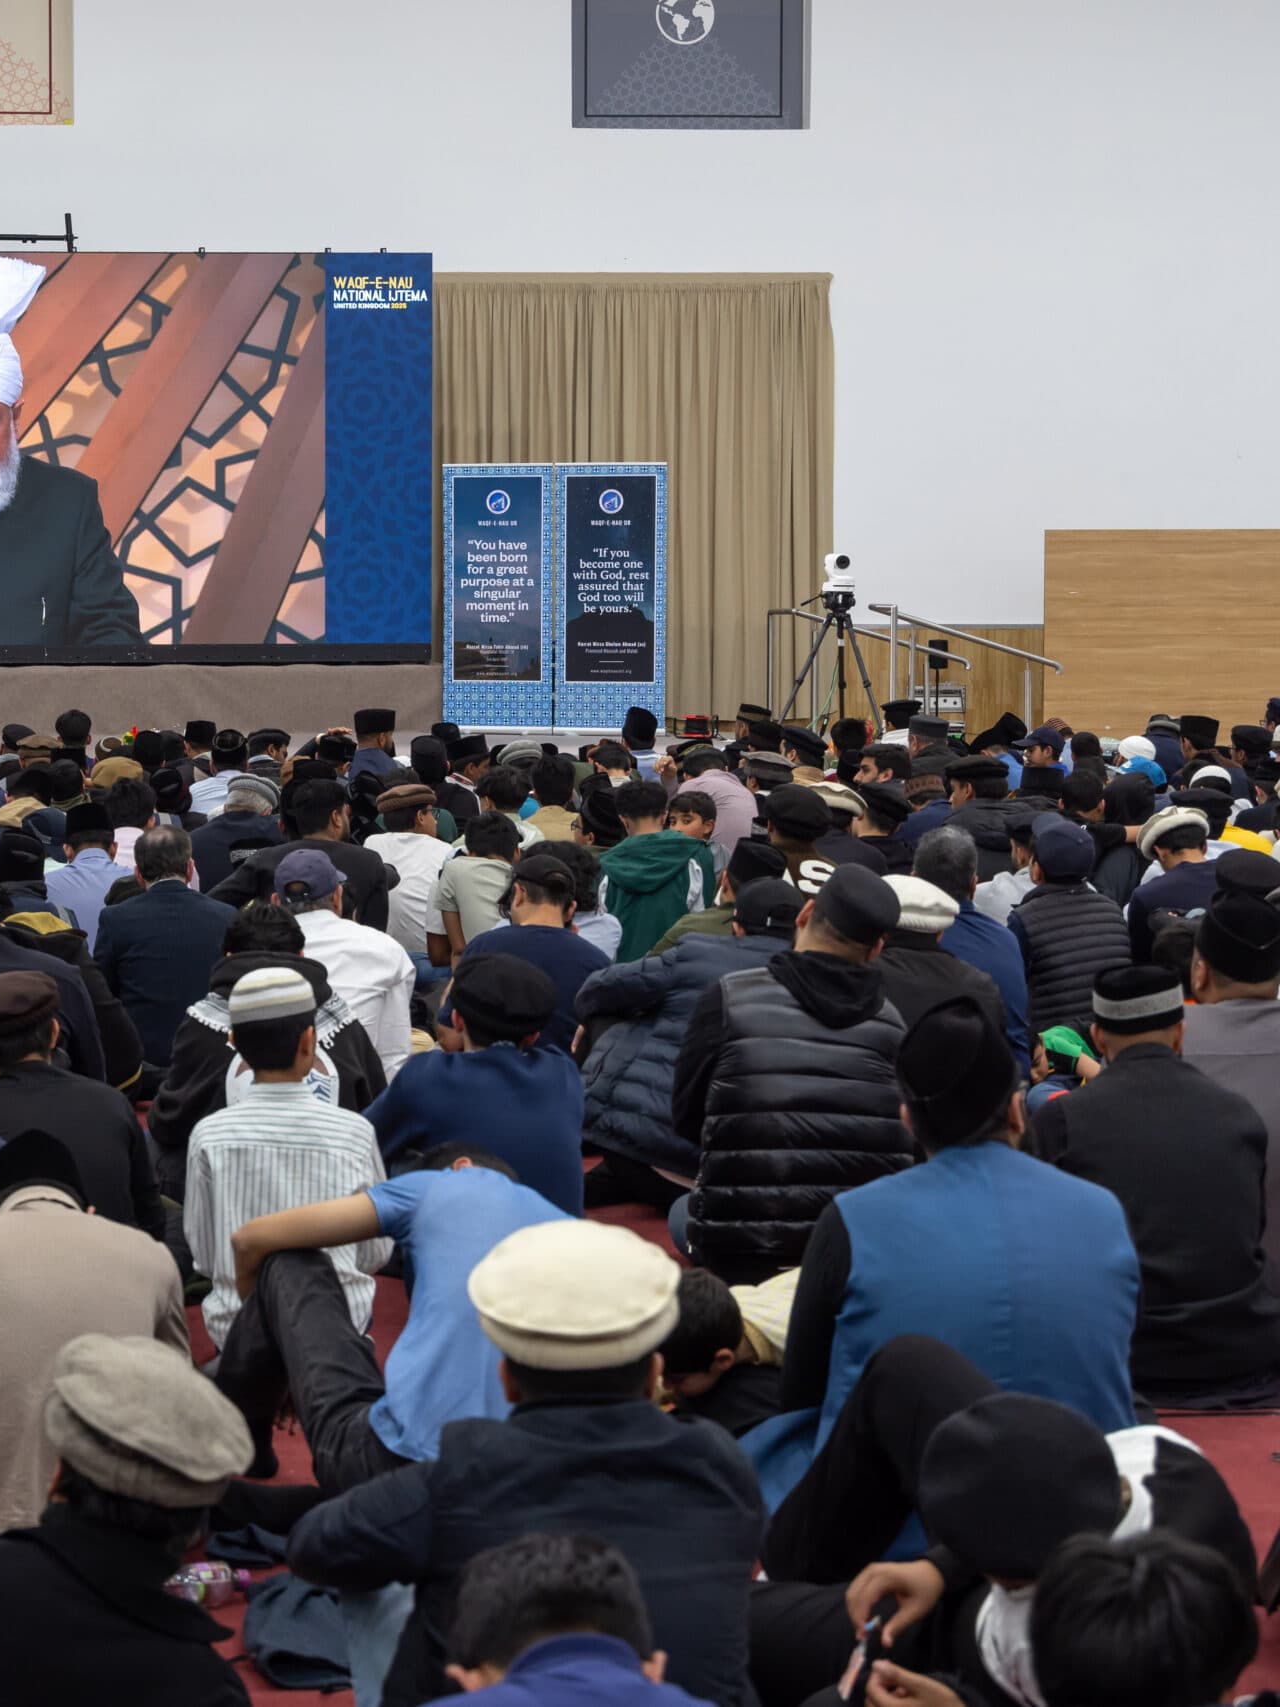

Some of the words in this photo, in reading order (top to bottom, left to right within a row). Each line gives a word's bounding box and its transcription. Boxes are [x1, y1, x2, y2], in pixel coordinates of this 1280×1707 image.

[334, 277, 413, 289] WAQF-E-NAU
[334, 290, 385, 301] NATIONAL
[389, 290, 427, 301] IJTEMA
[499, 540, 527, 550] have
[468, 552, 497, 562] been
[500, 552, 528, 562] born
[610, 550, 629, 560] you
[580, 559, 620, 568] become
[467, 564, 484, 574] for
[496, 565, 528, 576] great
[573, 570, 597, 579] with
[600, 570, 625, 580] God,
[461, 578, 509, 588] purpose
[513, 578, 524, 586] at
[527, 578, 534, 586] a
[578, 581, 619, 590] assured
[623, 581, 644, 590] that
[474, 589, 521, 600] singular
[578, 592, 600, 601] God
[624, 592, 644, 601] will
[466, 601, 515, 610] moment
[518, 600, 529, 610] in
[584, 603, 596, 613] be
